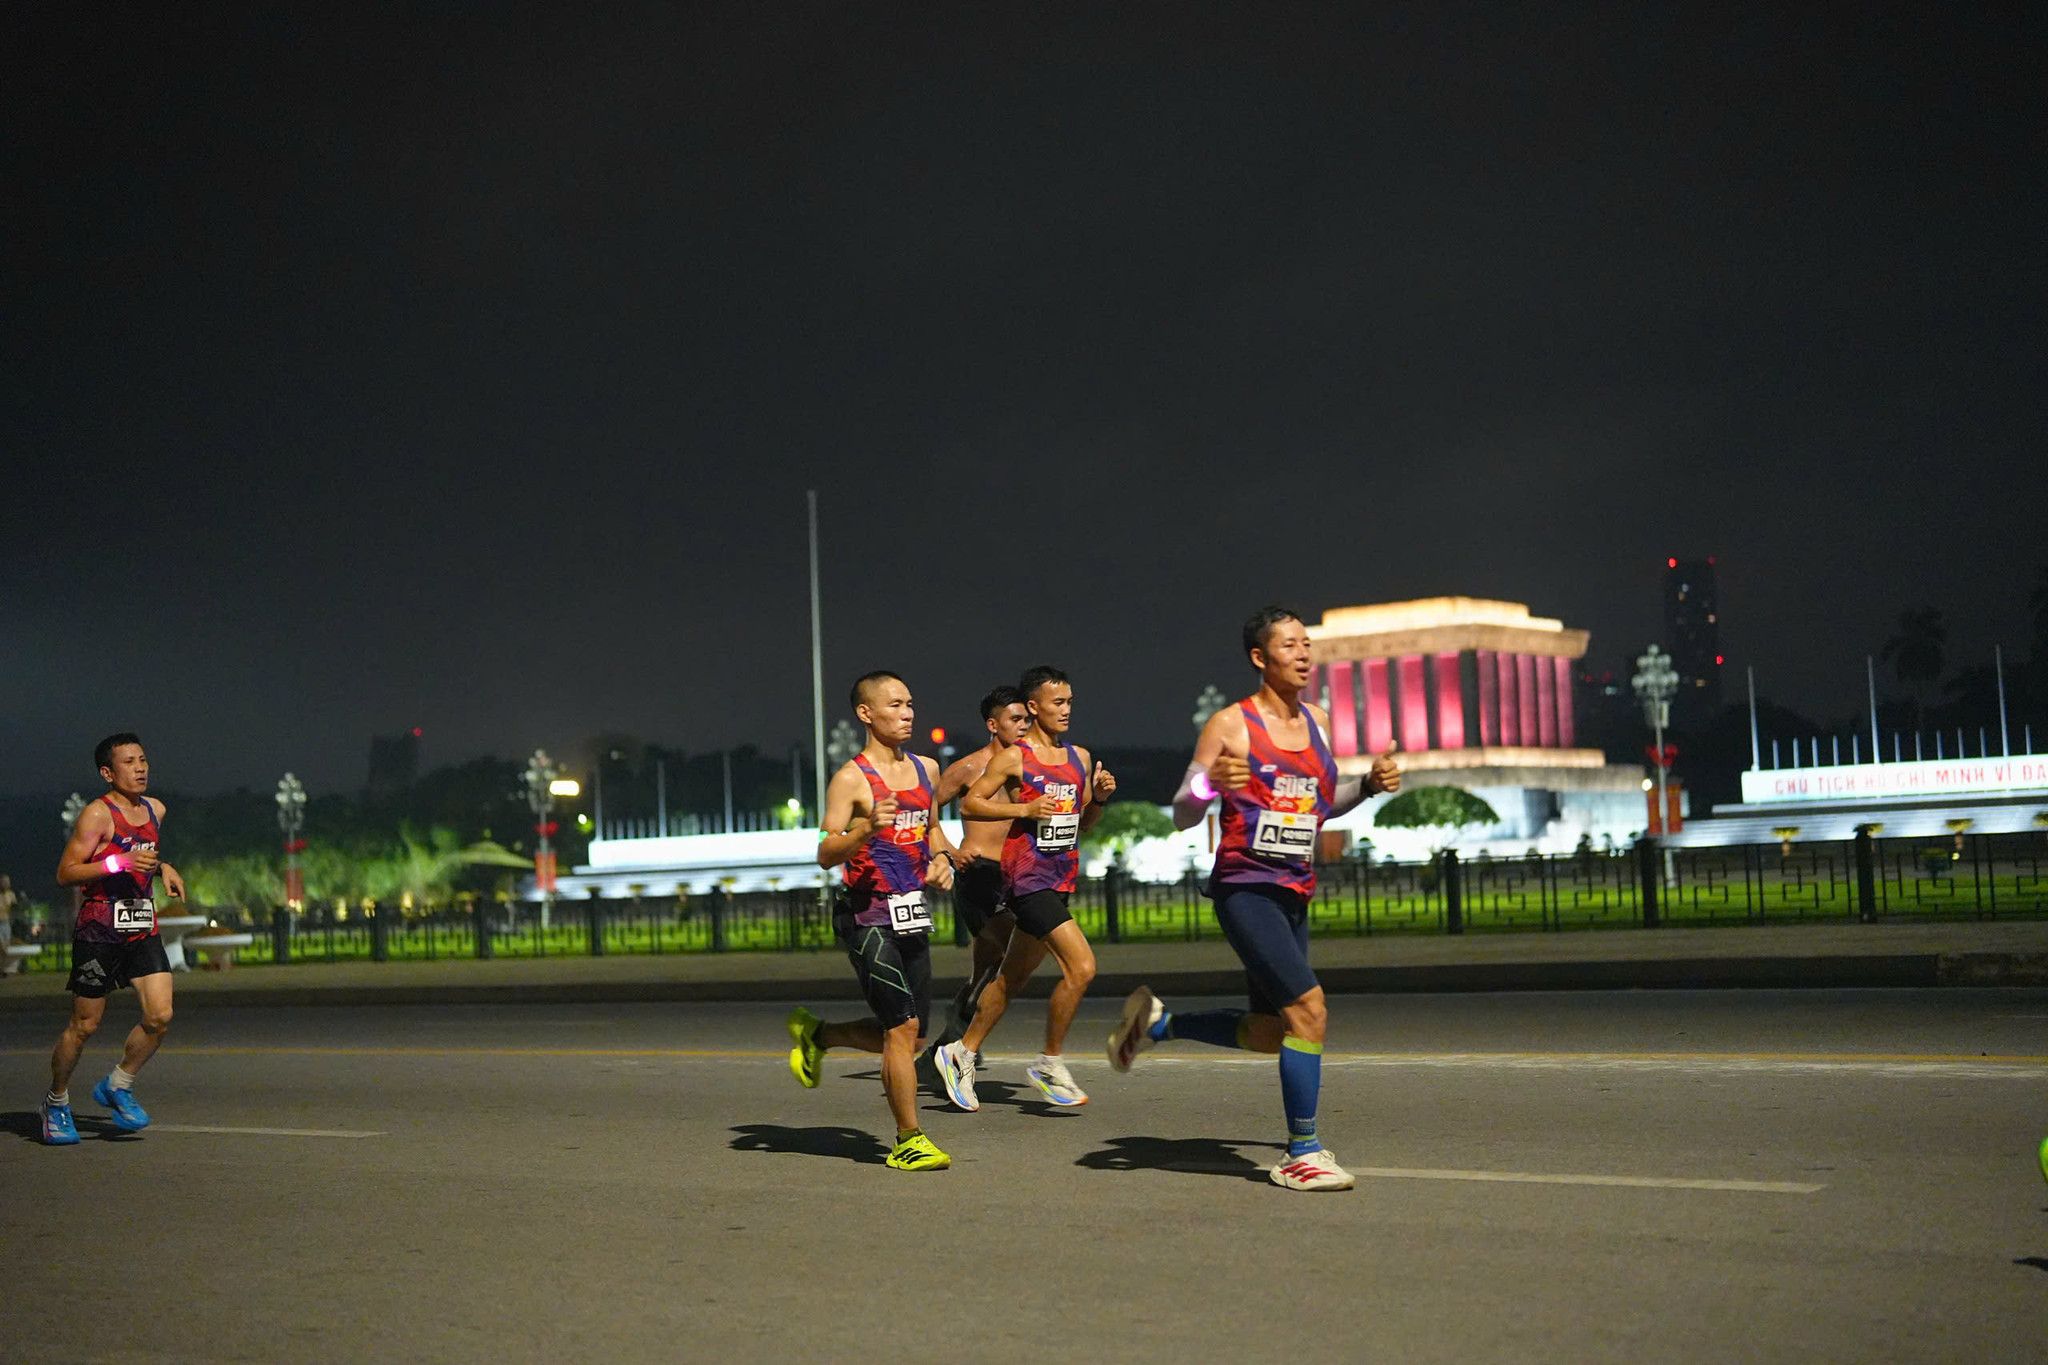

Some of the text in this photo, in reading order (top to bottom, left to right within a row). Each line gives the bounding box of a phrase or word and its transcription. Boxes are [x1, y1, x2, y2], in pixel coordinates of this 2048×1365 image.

[1935, 766, 1984, 785] MINH
[1045, 784, 1077, 800] SUB3
[1272, 776, 1319, 798] SUB3
[894, 810, 929, 830] SUB3
[1043, 827, 1053, 839] B
[1261, 826, 1277, 843] A
[119, 910, 131, 922] A
[896, 907, 910, 921] B
